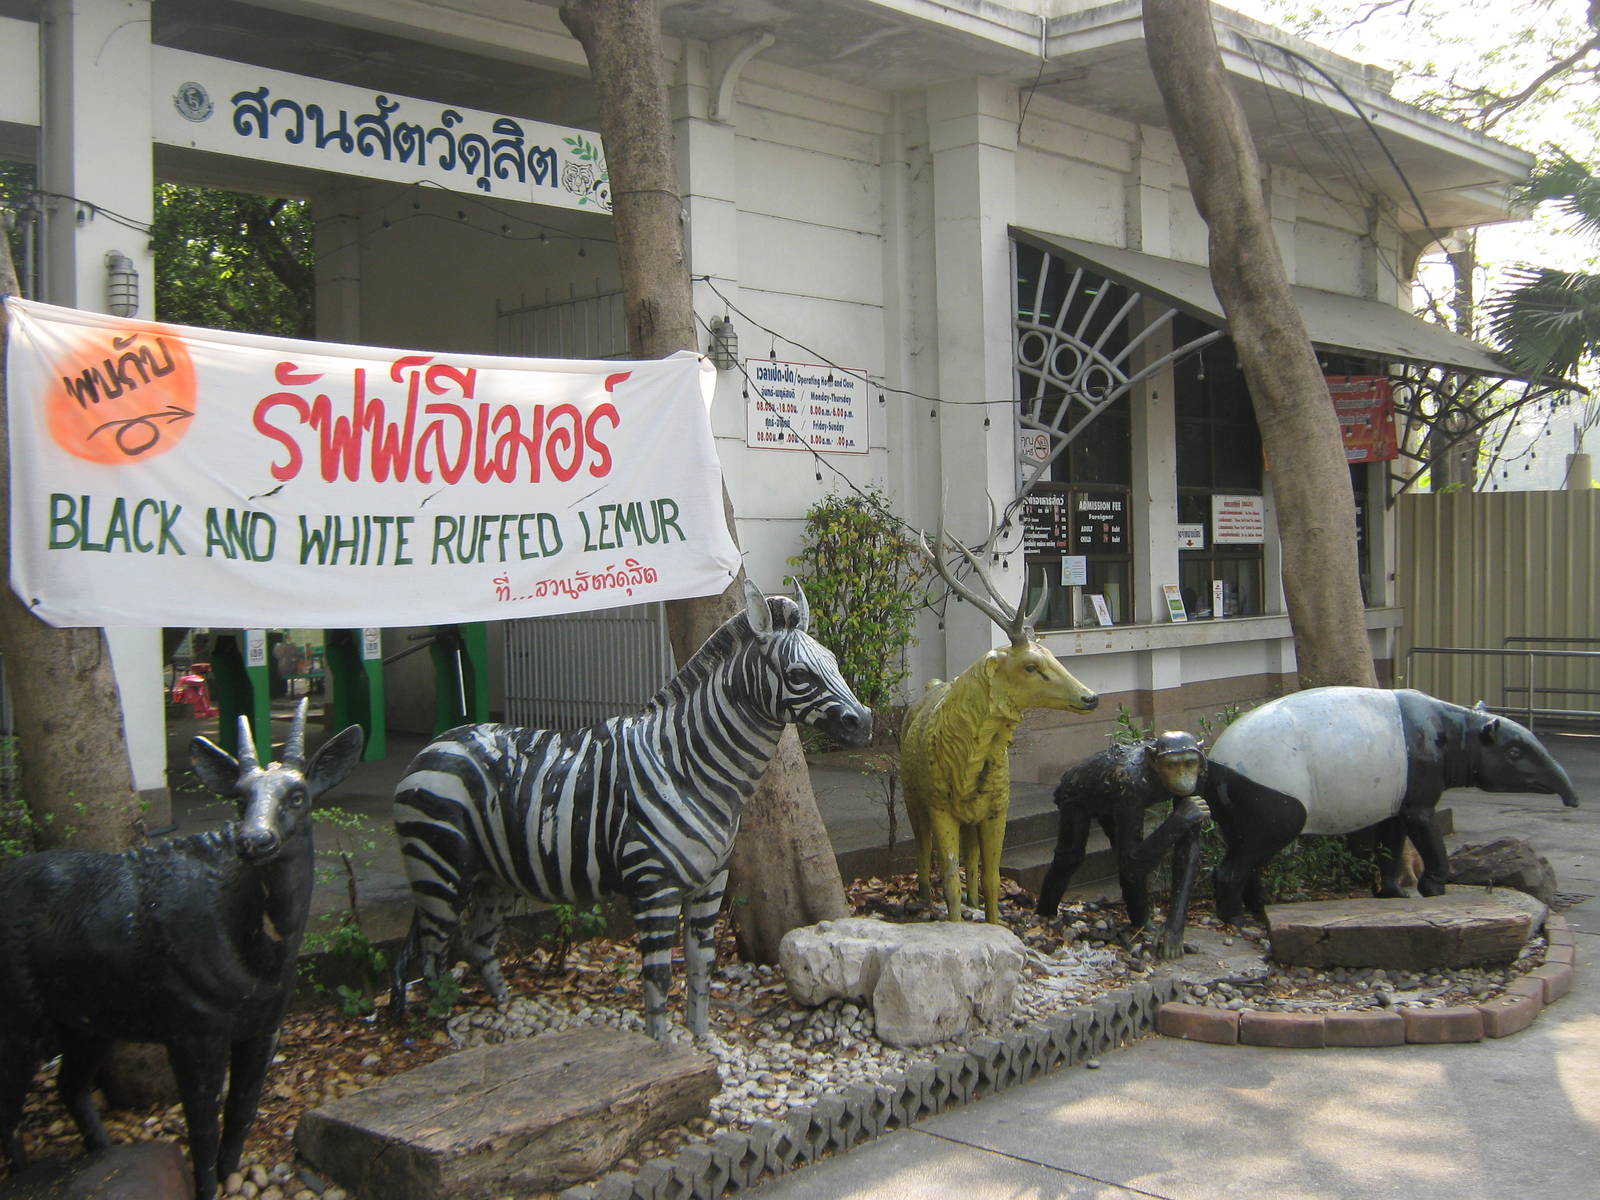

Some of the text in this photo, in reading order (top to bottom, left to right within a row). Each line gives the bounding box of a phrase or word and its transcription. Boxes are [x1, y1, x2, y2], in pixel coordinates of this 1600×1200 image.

[230, 86, 558, 192] สวนสัตว์ดุสิต
[62, 333, 175, 409] พบกับ
[48, 493, 687, 566] BLACK AND WHITE RUFFED LEMUR
[1079, 500, 1121, 511] ADMISSION FEE
